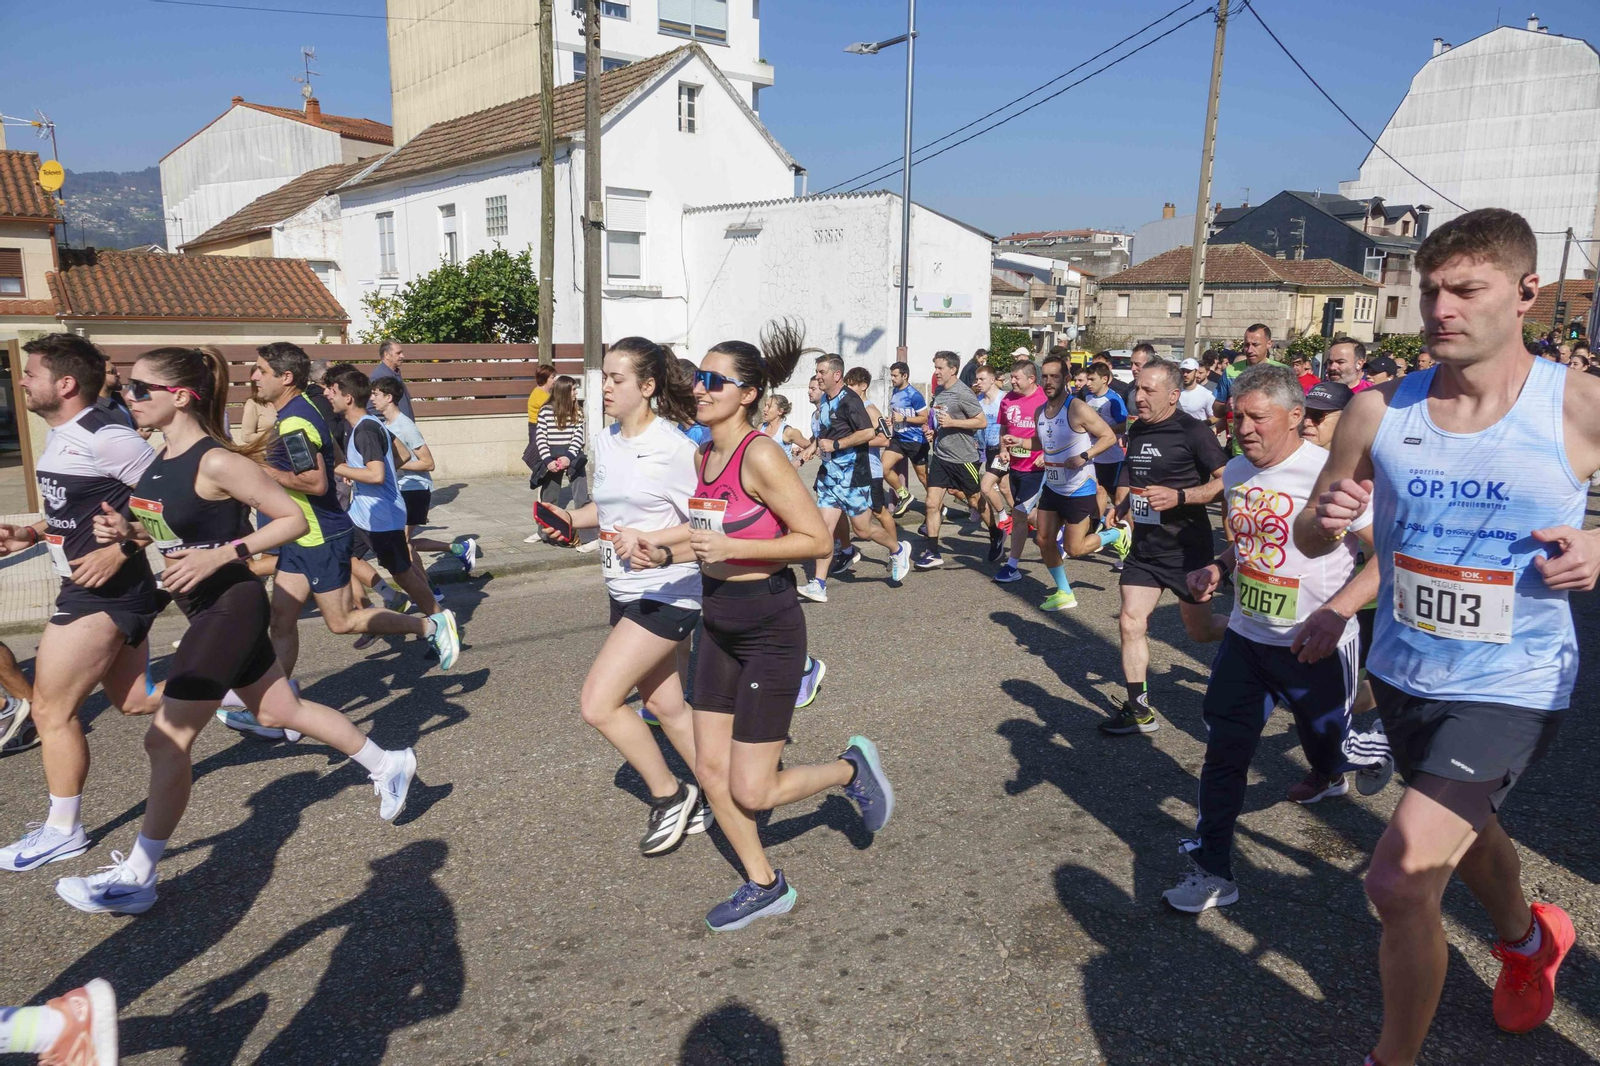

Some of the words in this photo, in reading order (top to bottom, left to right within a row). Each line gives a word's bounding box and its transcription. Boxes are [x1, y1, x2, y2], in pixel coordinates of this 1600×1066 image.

[1477, 530, 1518, 541] GADIS
[1424, 563, 1460, 577] PORRIÑO
[1430, 579, 1464, 591] MIGUEL
[1240, 582, 1287, 616] 2067
[1416, 584, 1482, 628] 603
